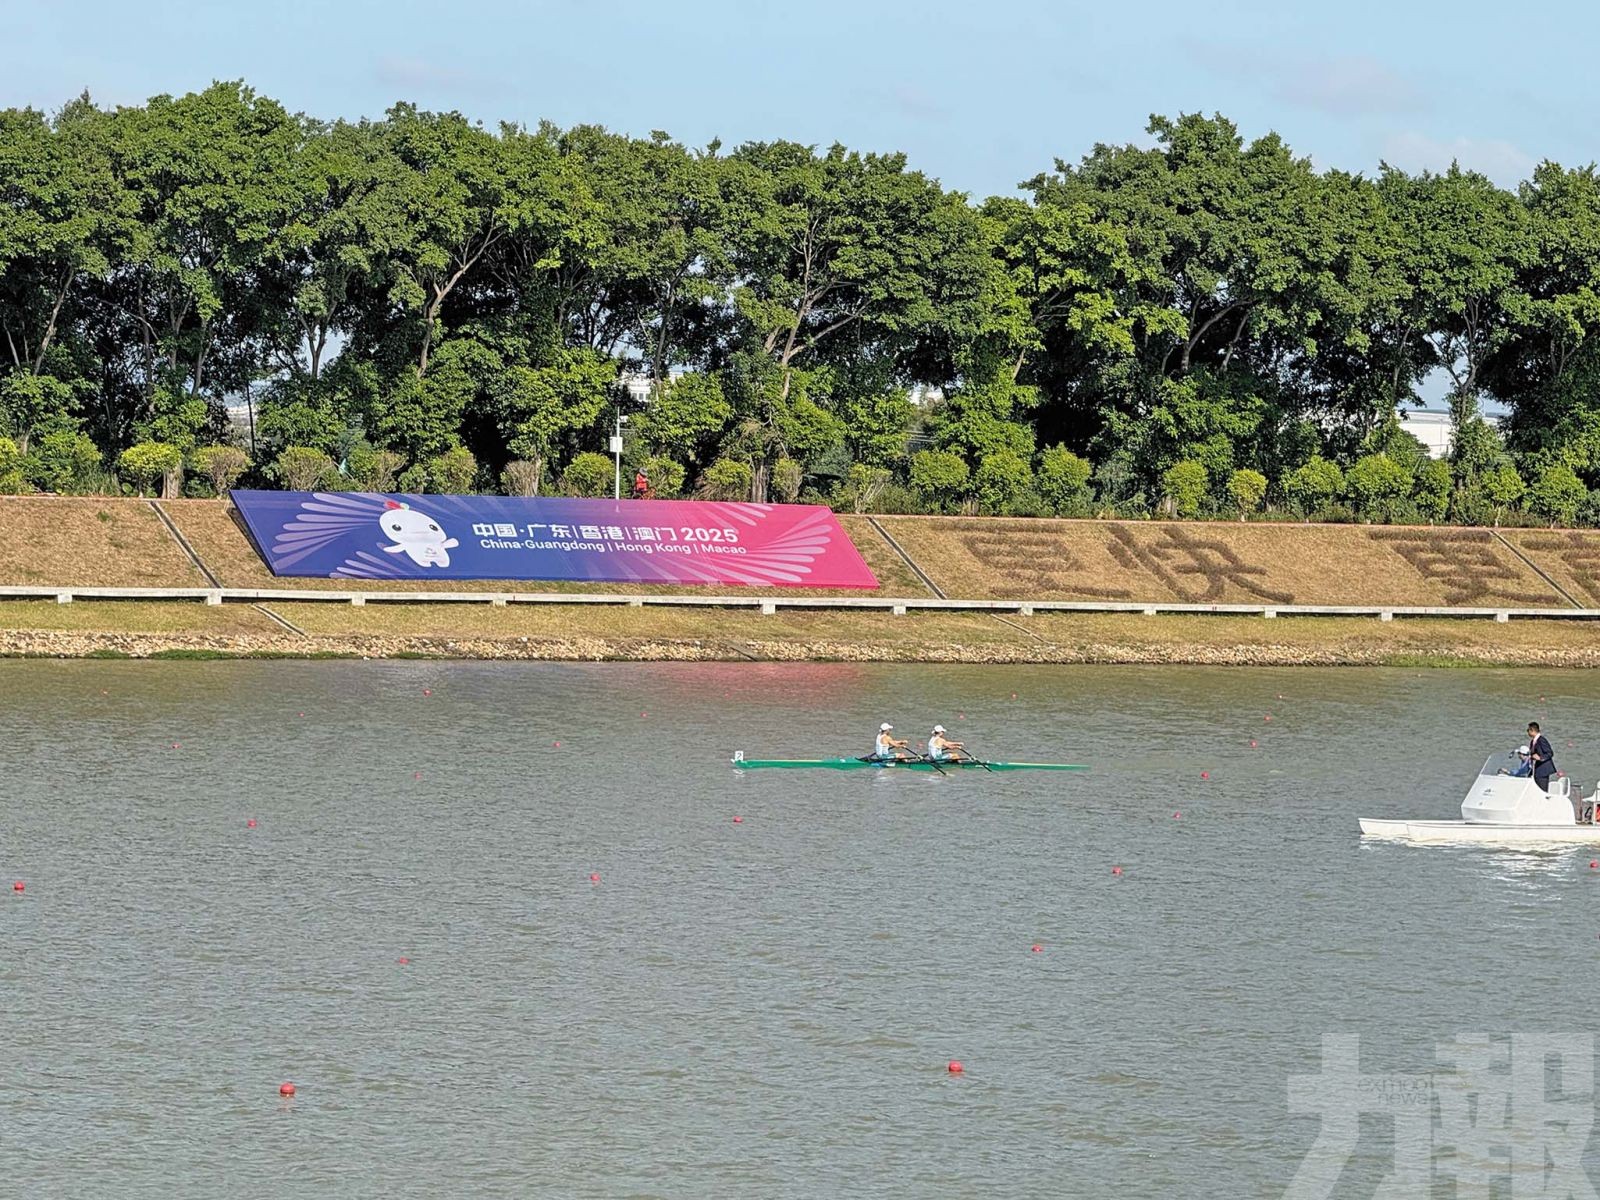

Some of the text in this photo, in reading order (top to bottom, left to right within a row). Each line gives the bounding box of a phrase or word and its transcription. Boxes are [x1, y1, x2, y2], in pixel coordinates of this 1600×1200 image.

[680, 527, 738, 542] 2025
[616, 542, 653, 554] Hong
[655, 543, 692, 554] Kong
[701, 544, 747, 554] Macao
